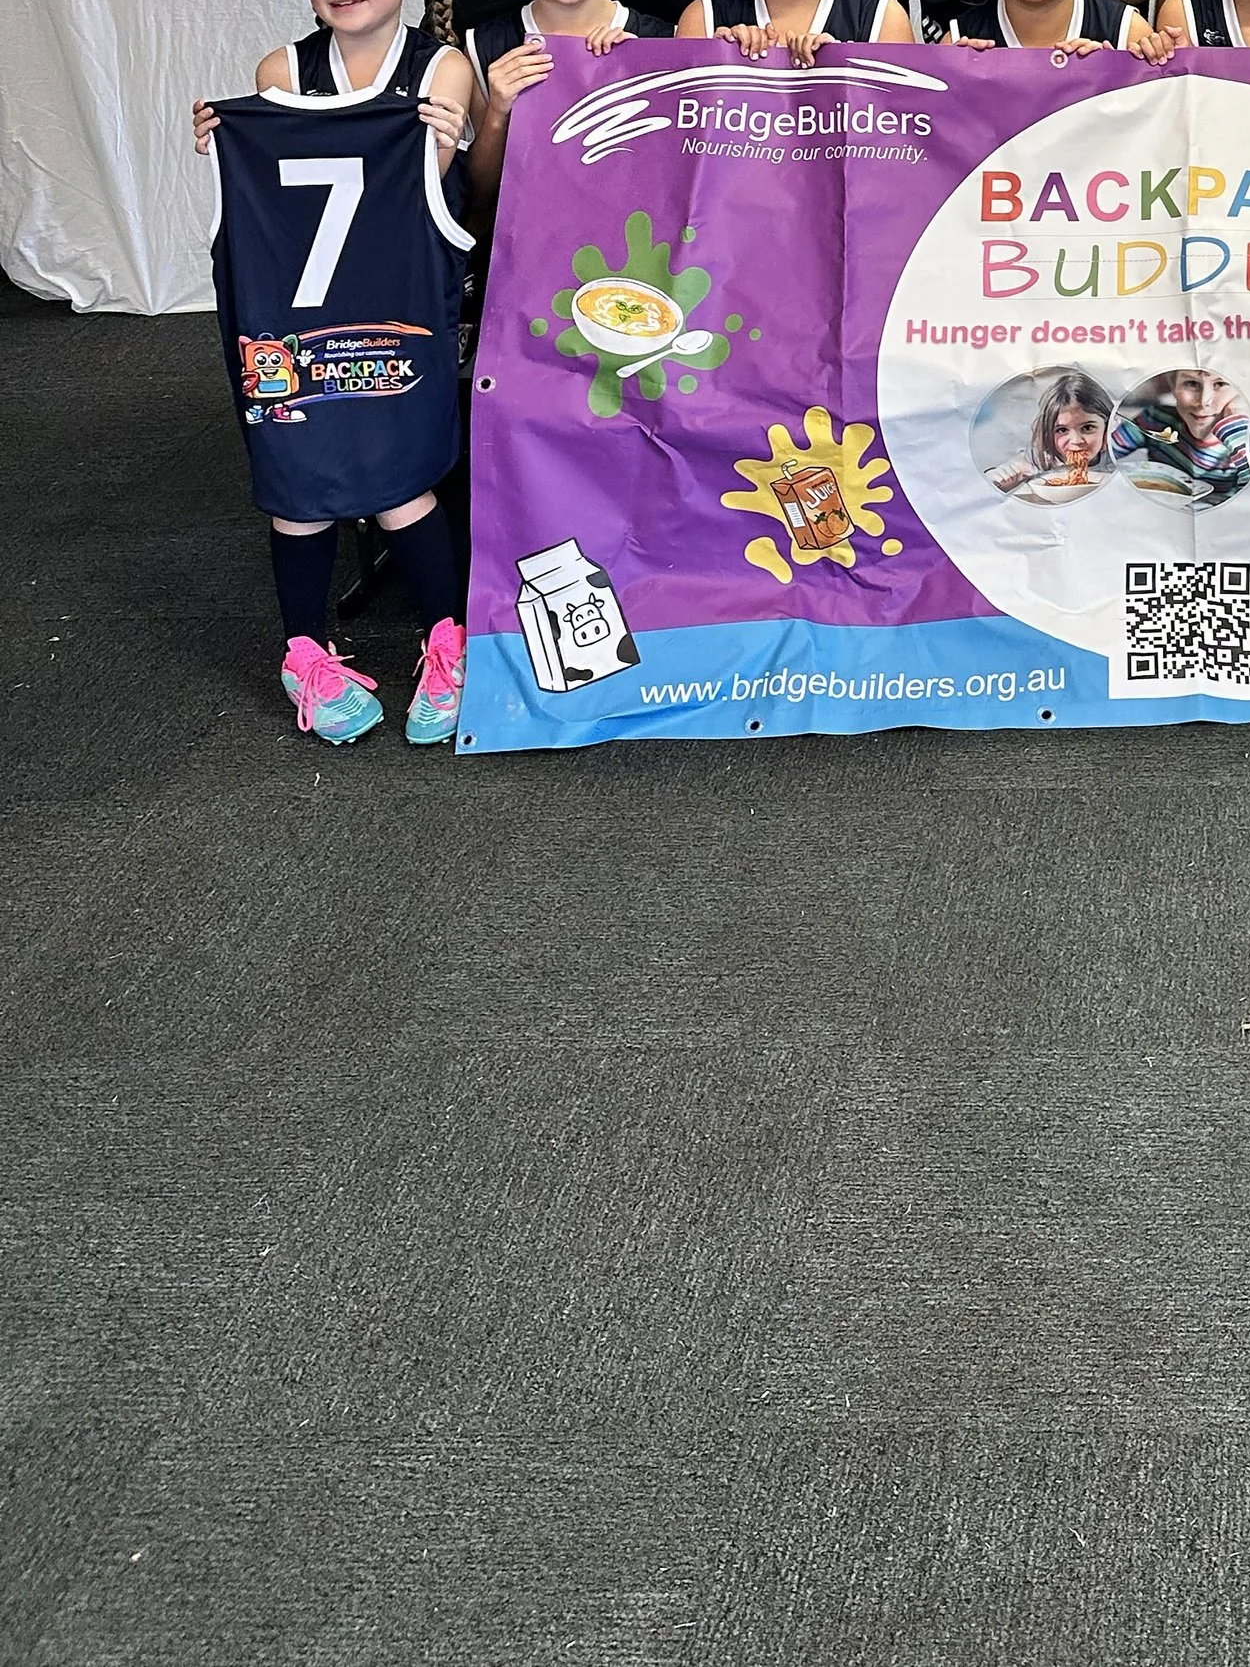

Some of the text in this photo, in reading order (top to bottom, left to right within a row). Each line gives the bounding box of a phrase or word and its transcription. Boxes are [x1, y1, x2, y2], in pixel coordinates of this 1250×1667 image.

[676, 98, 932, 142] BridgeBuilders
[681, 137, 929, 165] Nourishing our community.
[278, 157, 364, 308] 7
[326, 338, 401, 350] BridgeBuilders
[905, 318, 1024, 348] Hunger
[1156, 314, 1215, 343] take
[311, 359, 415, 381] BACKPACK
[324, 376, 403, 393] BUDDIES
[639, 666, 1066, 705] www.bridgebuilders.org.au
